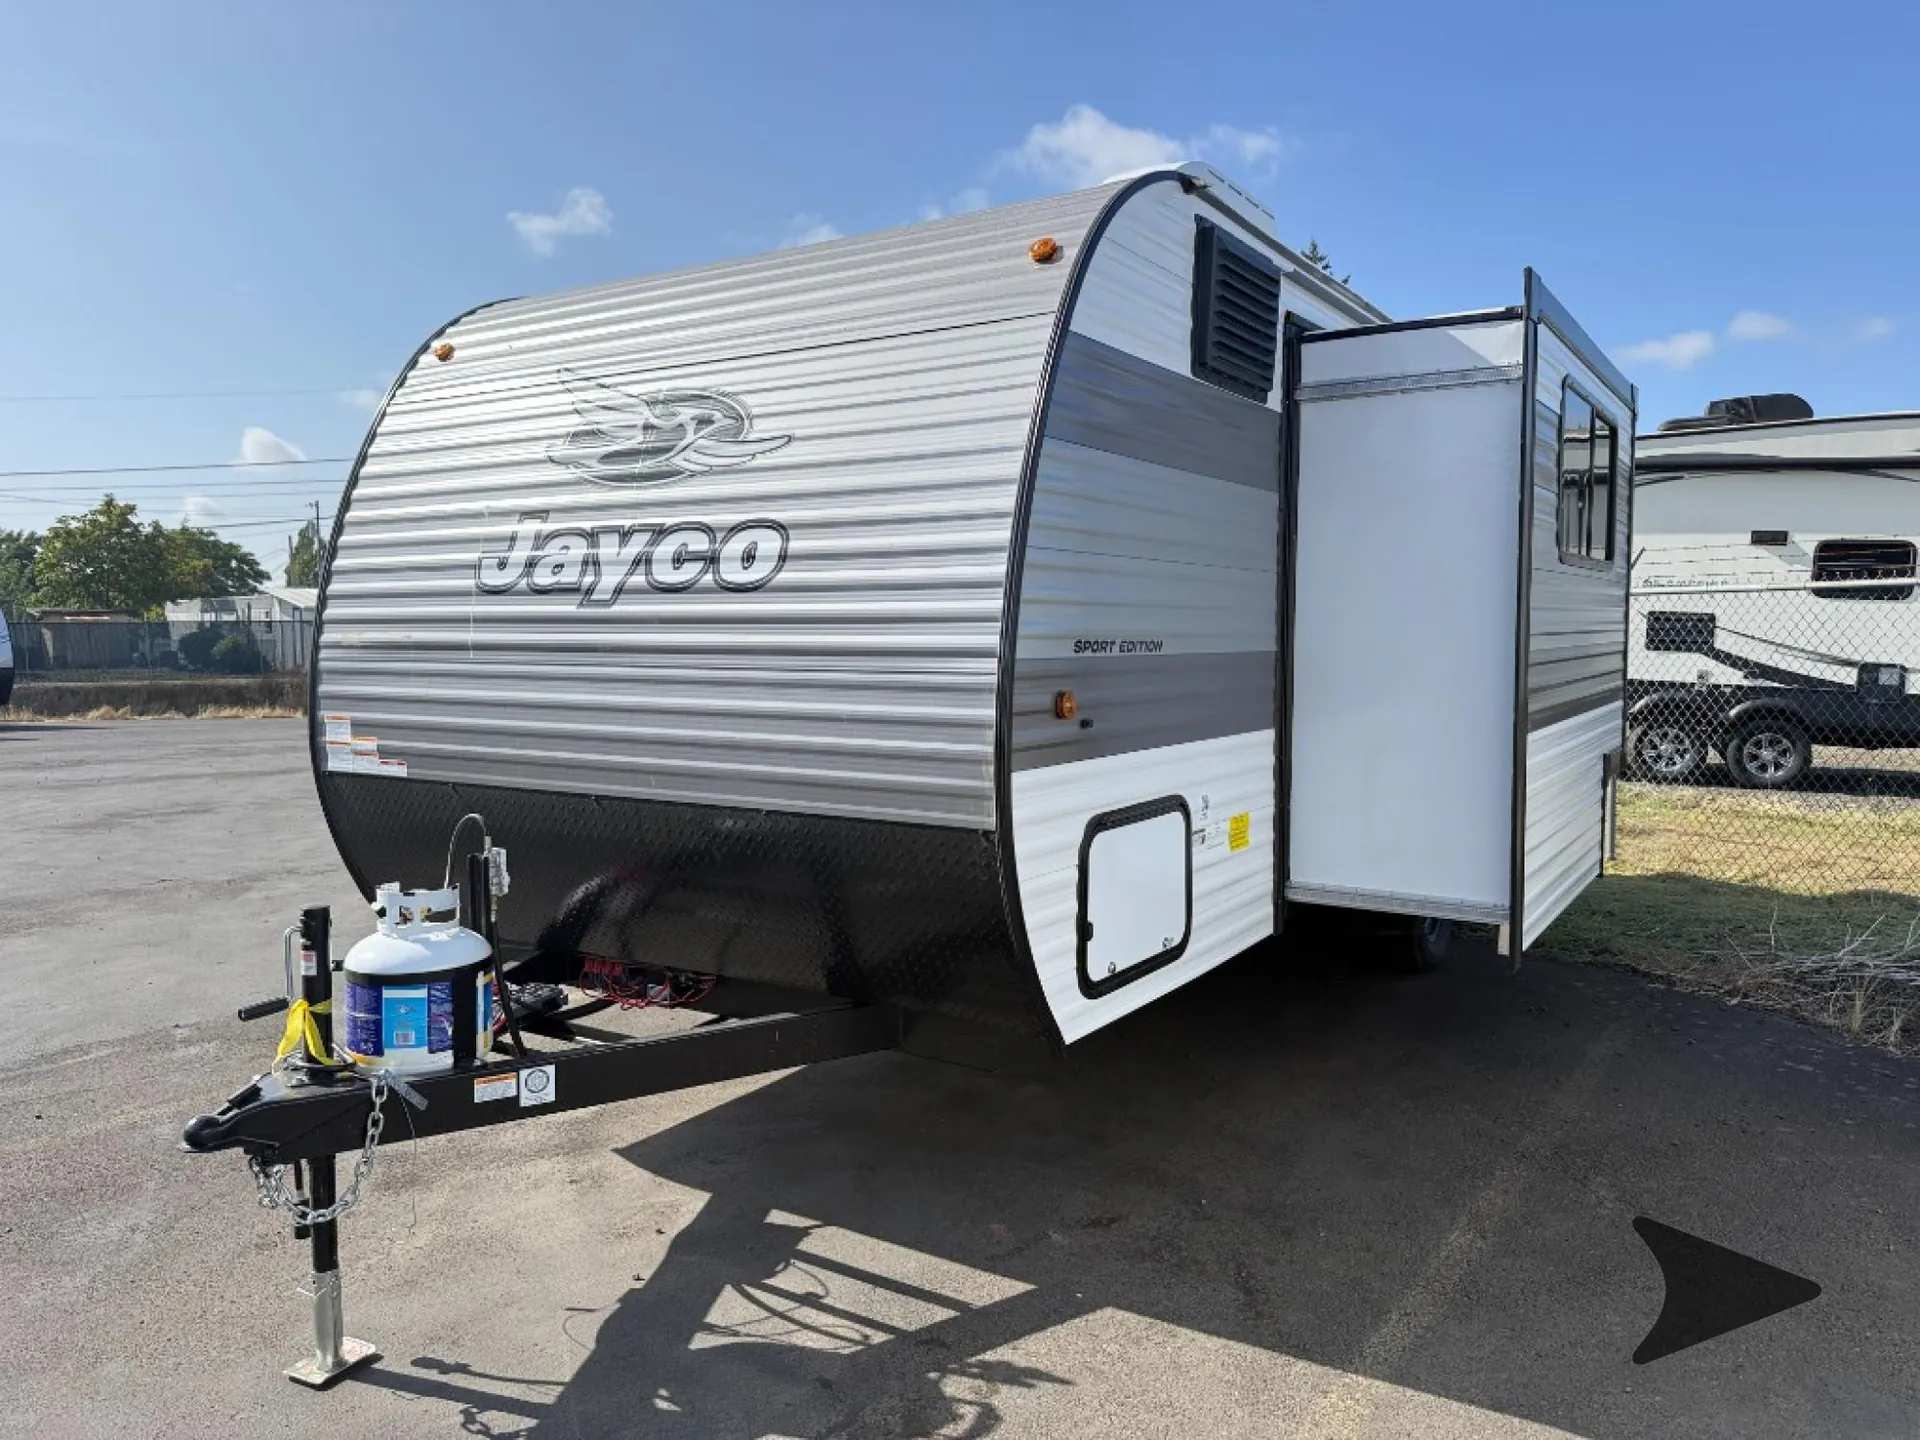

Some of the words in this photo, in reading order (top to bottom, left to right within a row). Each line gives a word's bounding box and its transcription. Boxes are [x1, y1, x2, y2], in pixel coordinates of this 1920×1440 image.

[475, 509, 790, 609] Jayco
[1073, 639, 1116, 654] SPORT
[1119, 639, 1164, 654] EDITION
